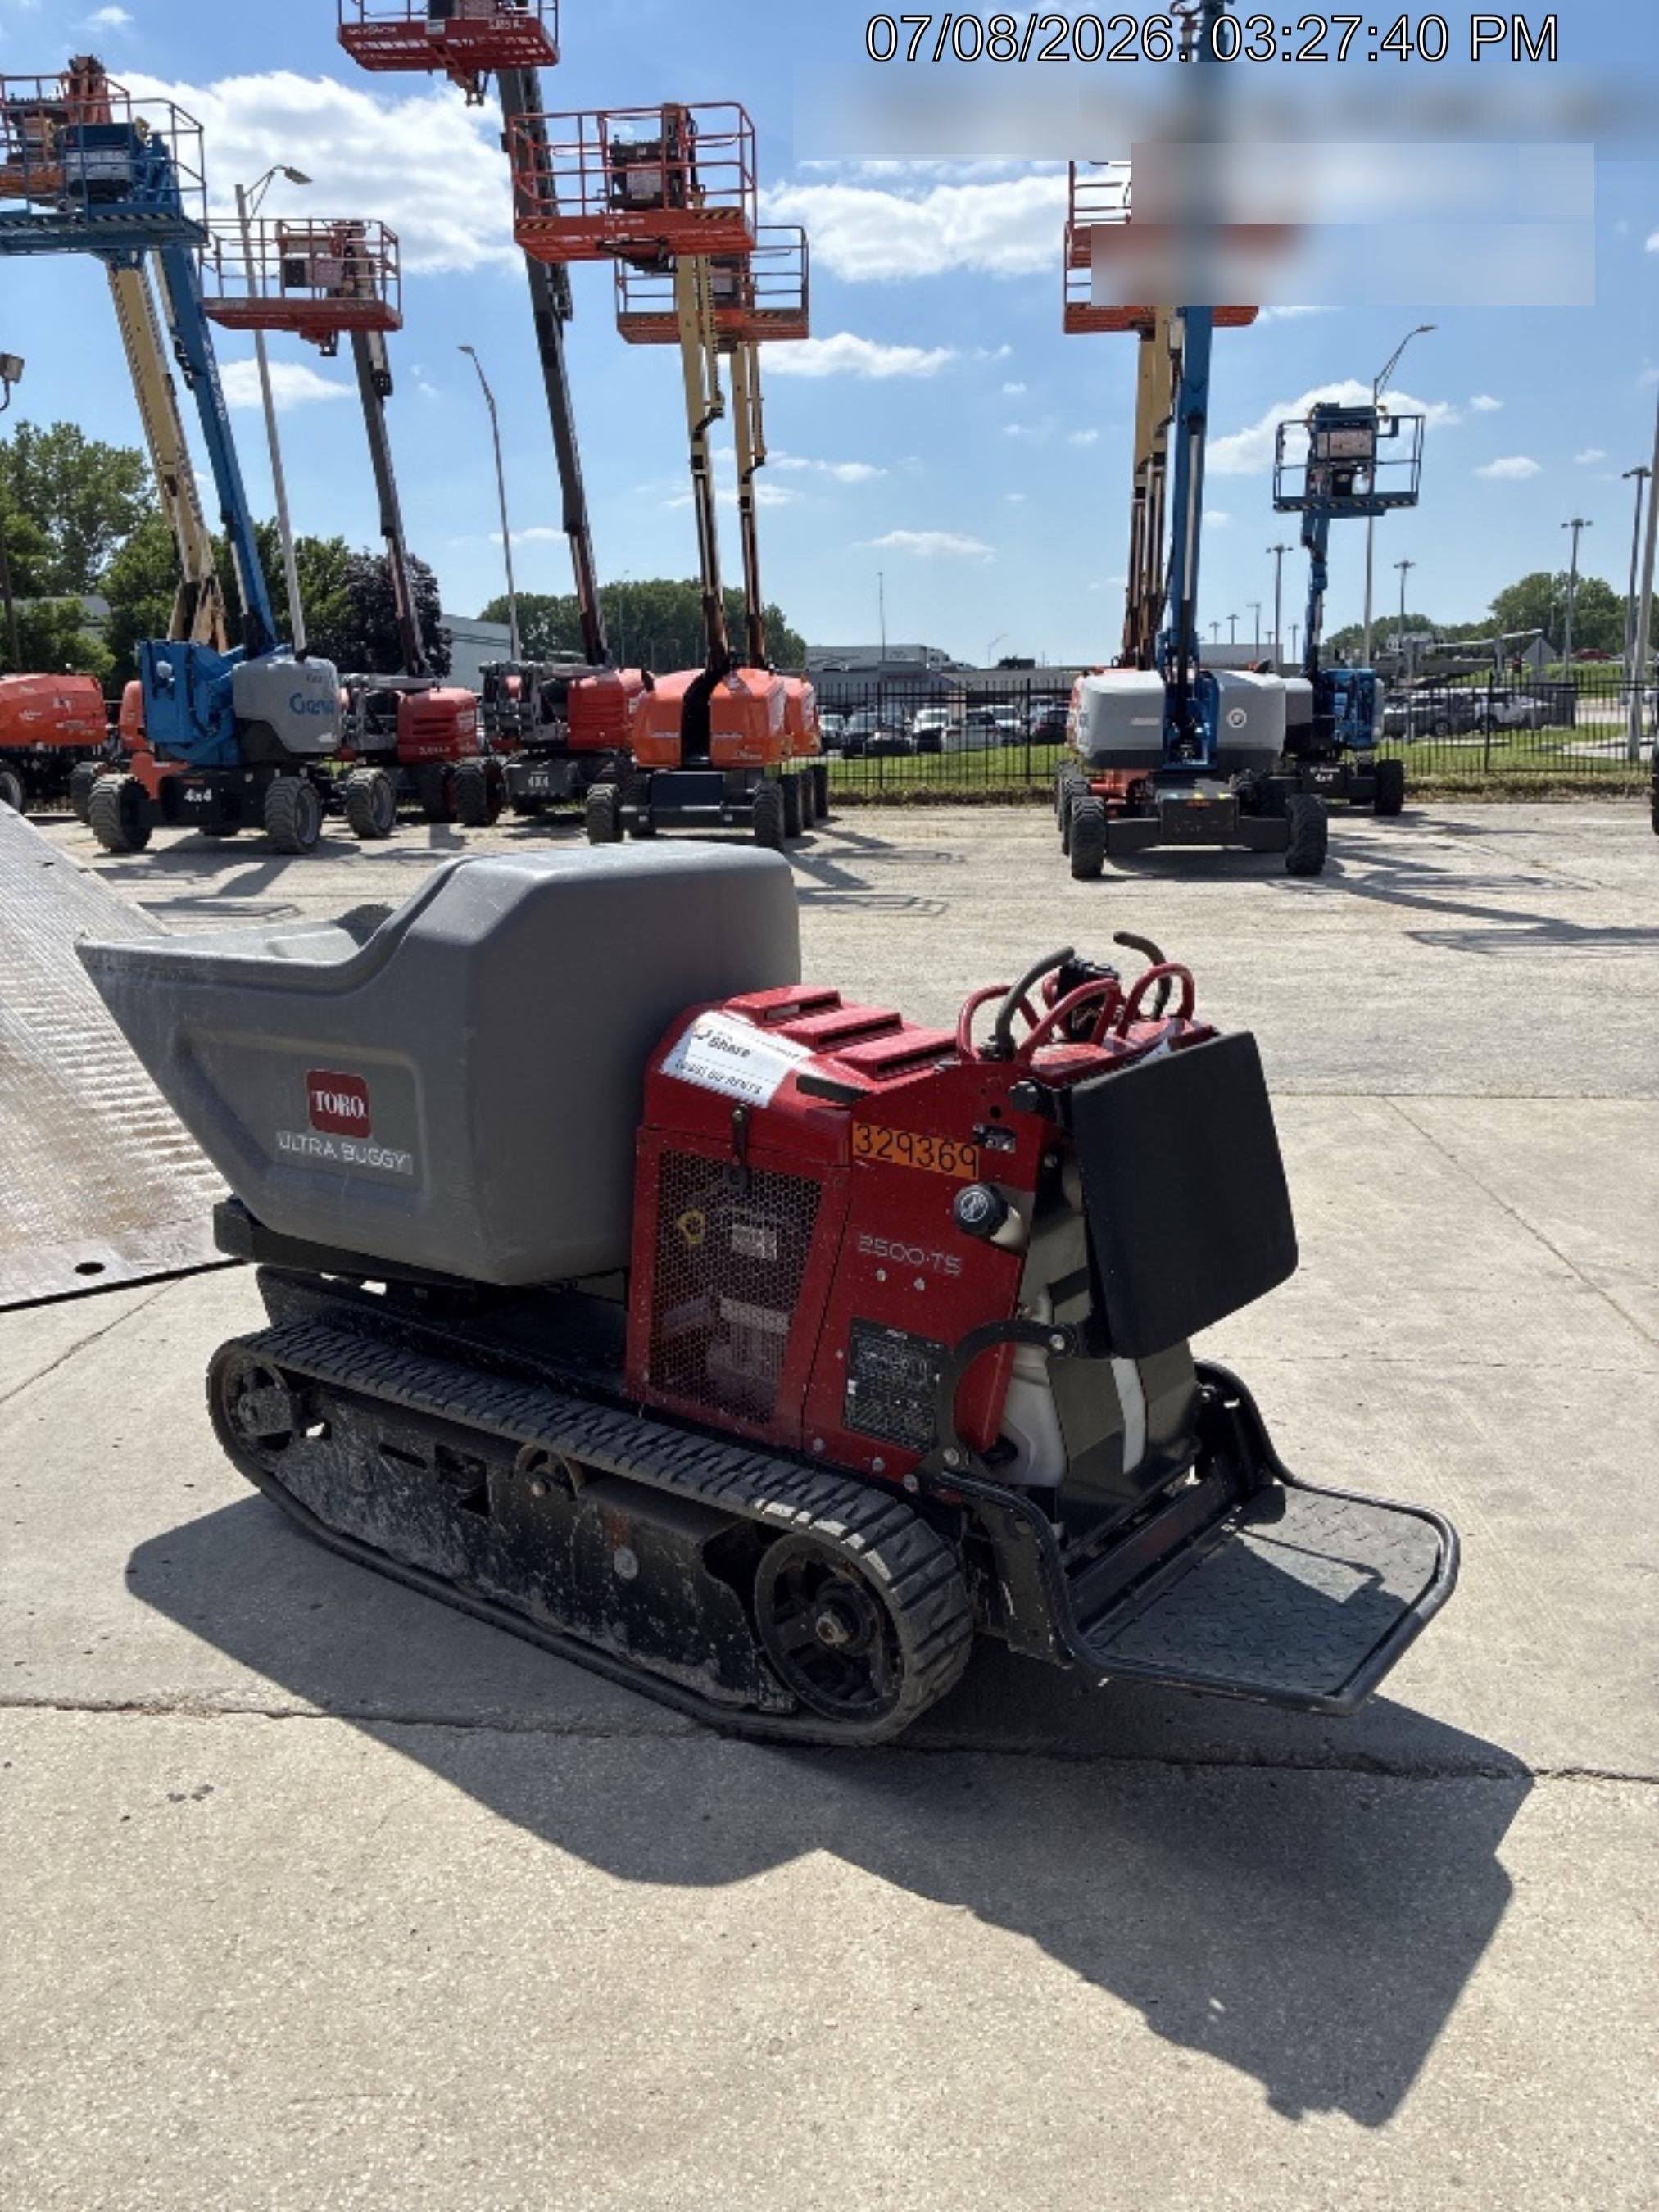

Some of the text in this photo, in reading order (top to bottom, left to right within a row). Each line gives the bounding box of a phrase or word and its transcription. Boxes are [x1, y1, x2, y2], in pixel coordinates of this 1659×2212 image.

[708, 1036, 751, 1058] Share
[311, 1090, 366, 1119] TORO
[278, 1133, 406, 1169] ULTRA BUGGY
[856, 1125, 977, 1178] 329369
